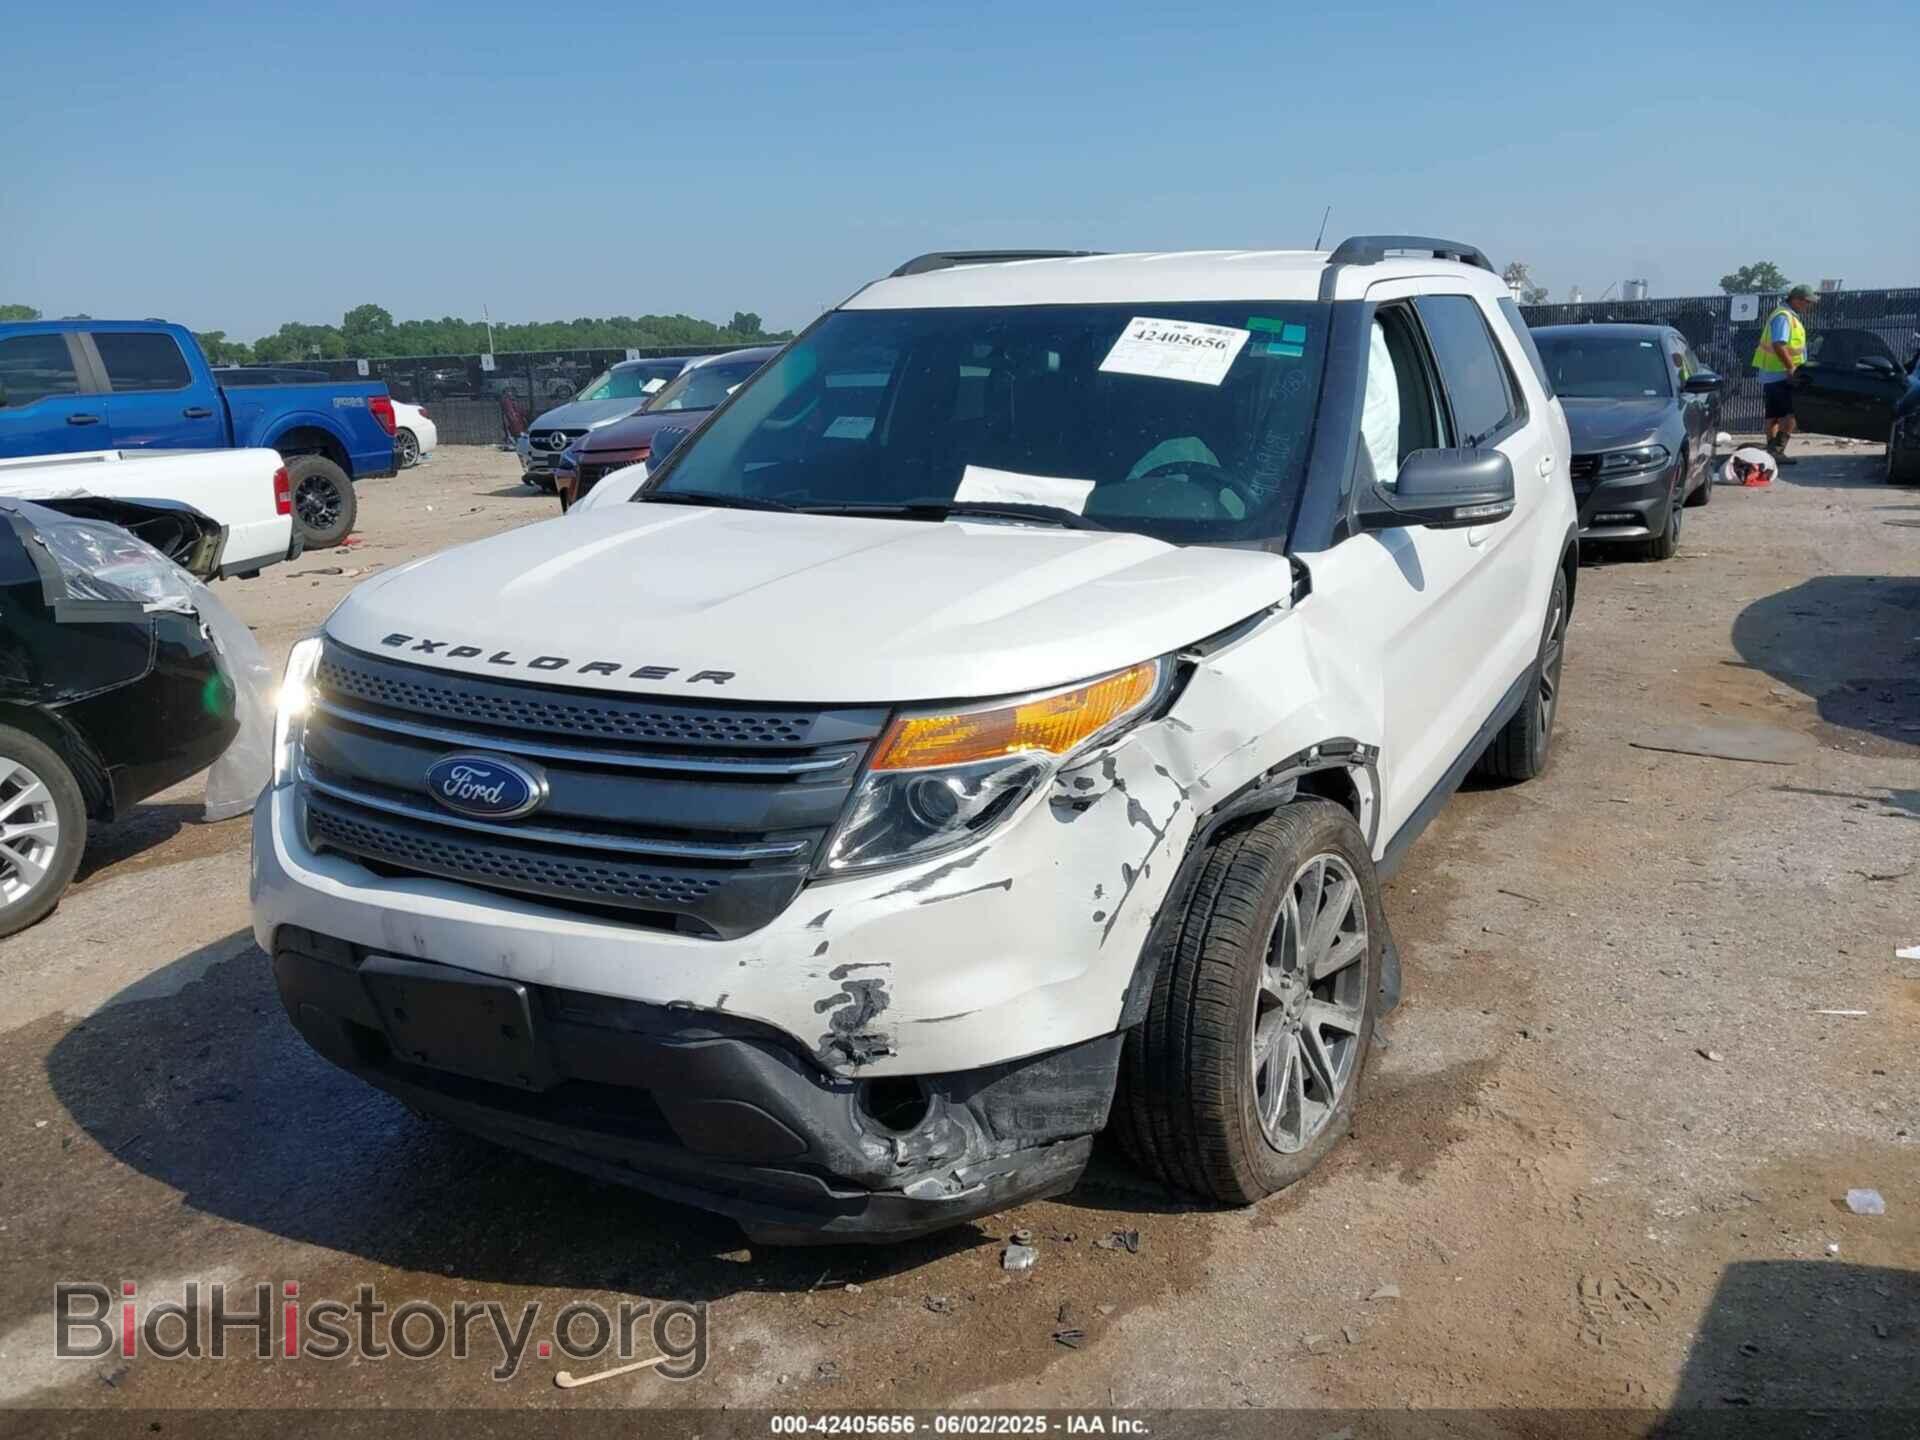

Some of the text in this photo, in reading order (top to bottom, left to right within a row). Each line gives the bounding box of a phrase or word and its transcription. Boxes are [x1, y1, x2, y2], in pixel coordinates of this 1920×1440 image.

[1133, 329, 1227, 350] 42405656
[380, 632, 736, 685] EXPLORER
[443, 765, 505, 804] Ford
